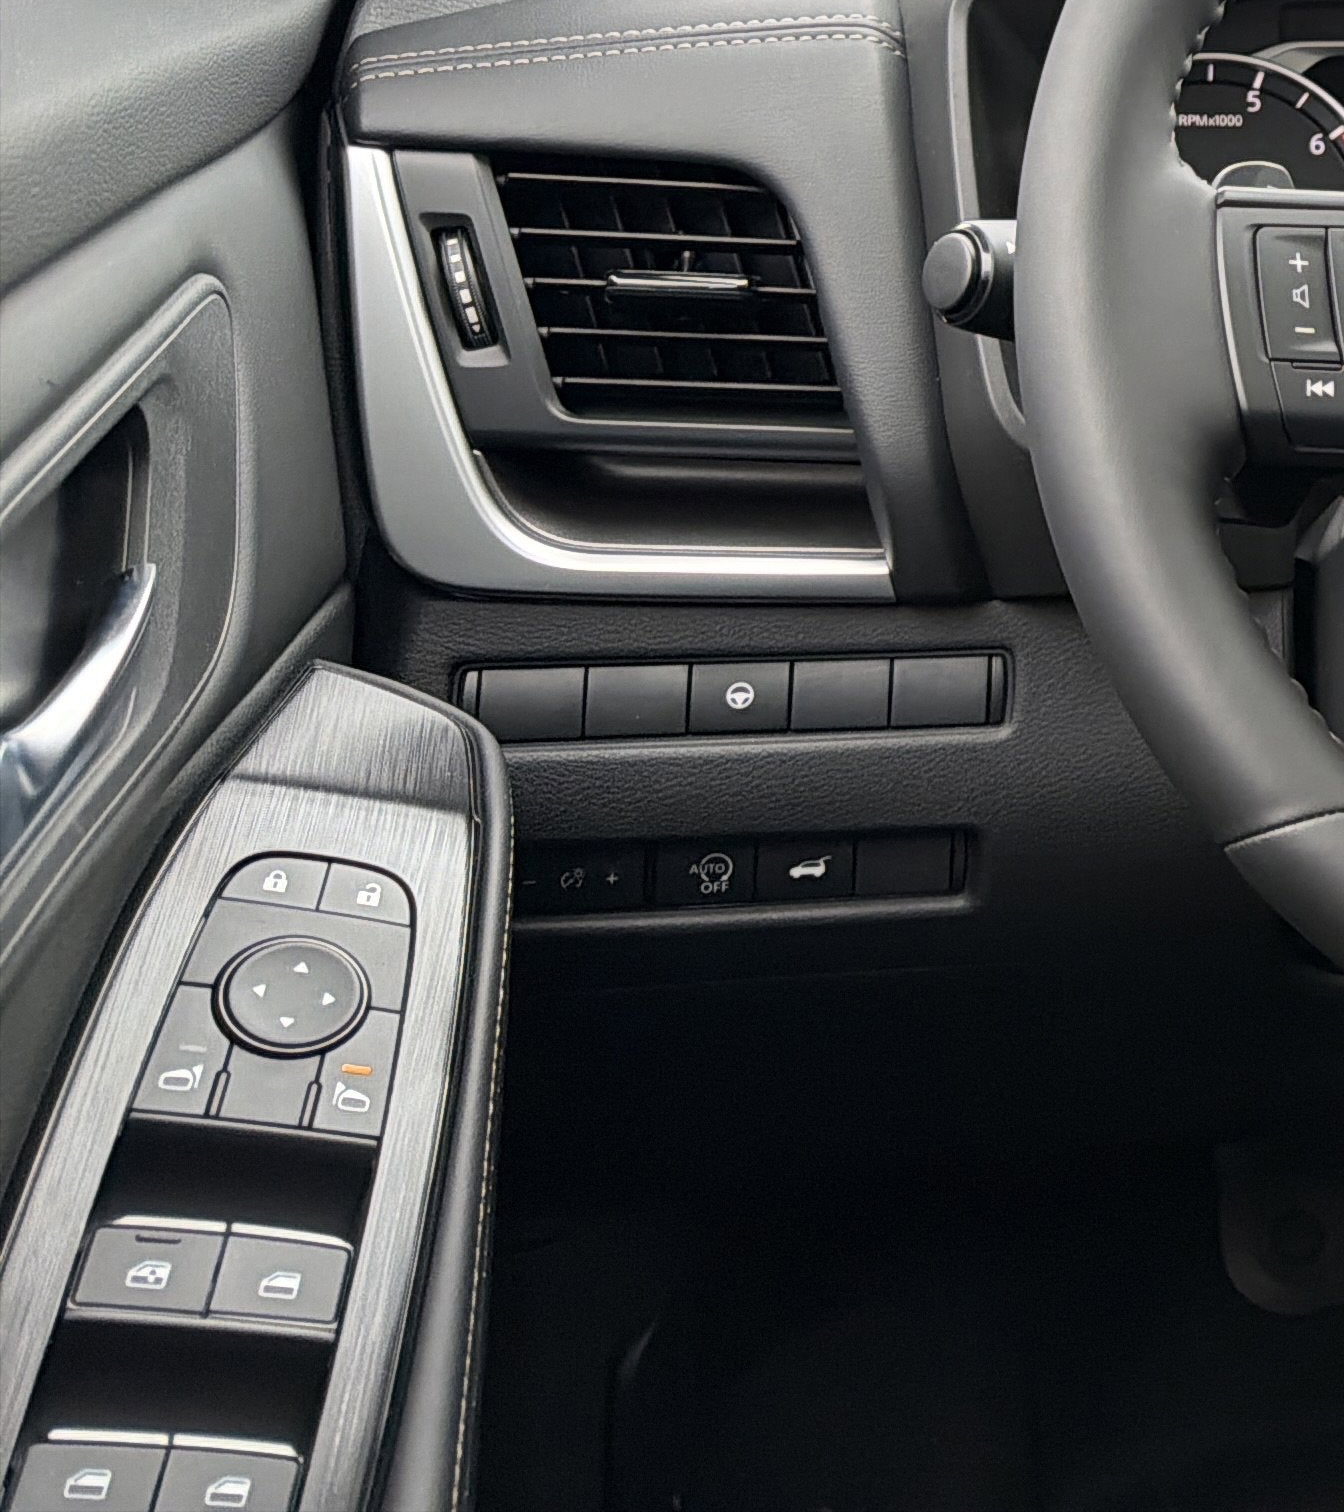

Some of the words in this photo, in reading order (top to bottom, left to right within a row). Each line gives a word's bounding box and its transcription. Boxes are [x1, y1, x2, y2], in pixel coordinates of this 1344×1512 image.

[1246, 90, 1262, 112] 5
[1309, 133, 1325, 155] 6
[689, 863, 726, 875] AUTO
[701, 881, 729, 894] OFF
